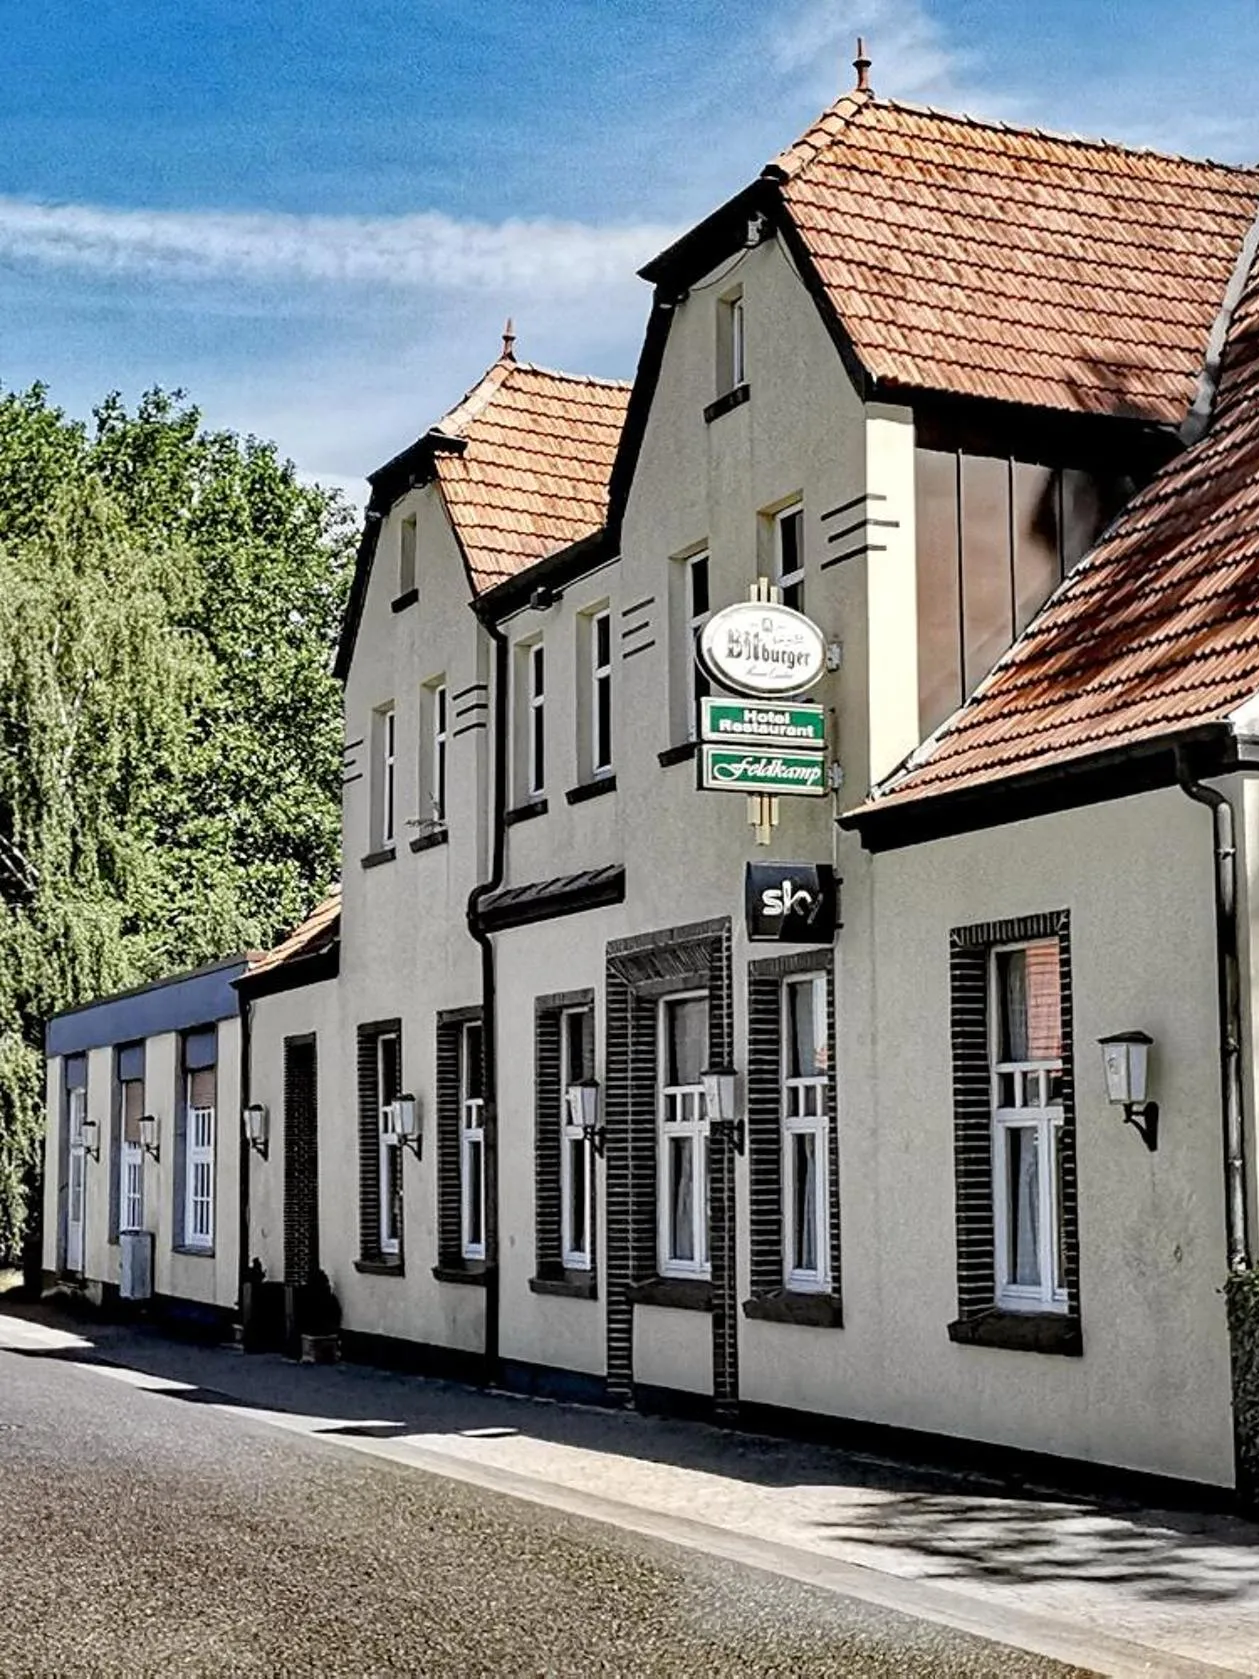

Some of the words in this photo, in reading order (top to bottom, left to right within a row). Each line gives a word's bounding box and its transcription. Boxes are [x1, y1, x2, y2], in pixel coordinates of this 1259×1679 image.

[725, 627, 812, 670] Bitburger
[719, 719, 815, 737] Restaurant
[743, 709, 791, 725] Hotel
[713, 757, 822, 786] Feldkamp
[762, 880, 824, 925] sky
